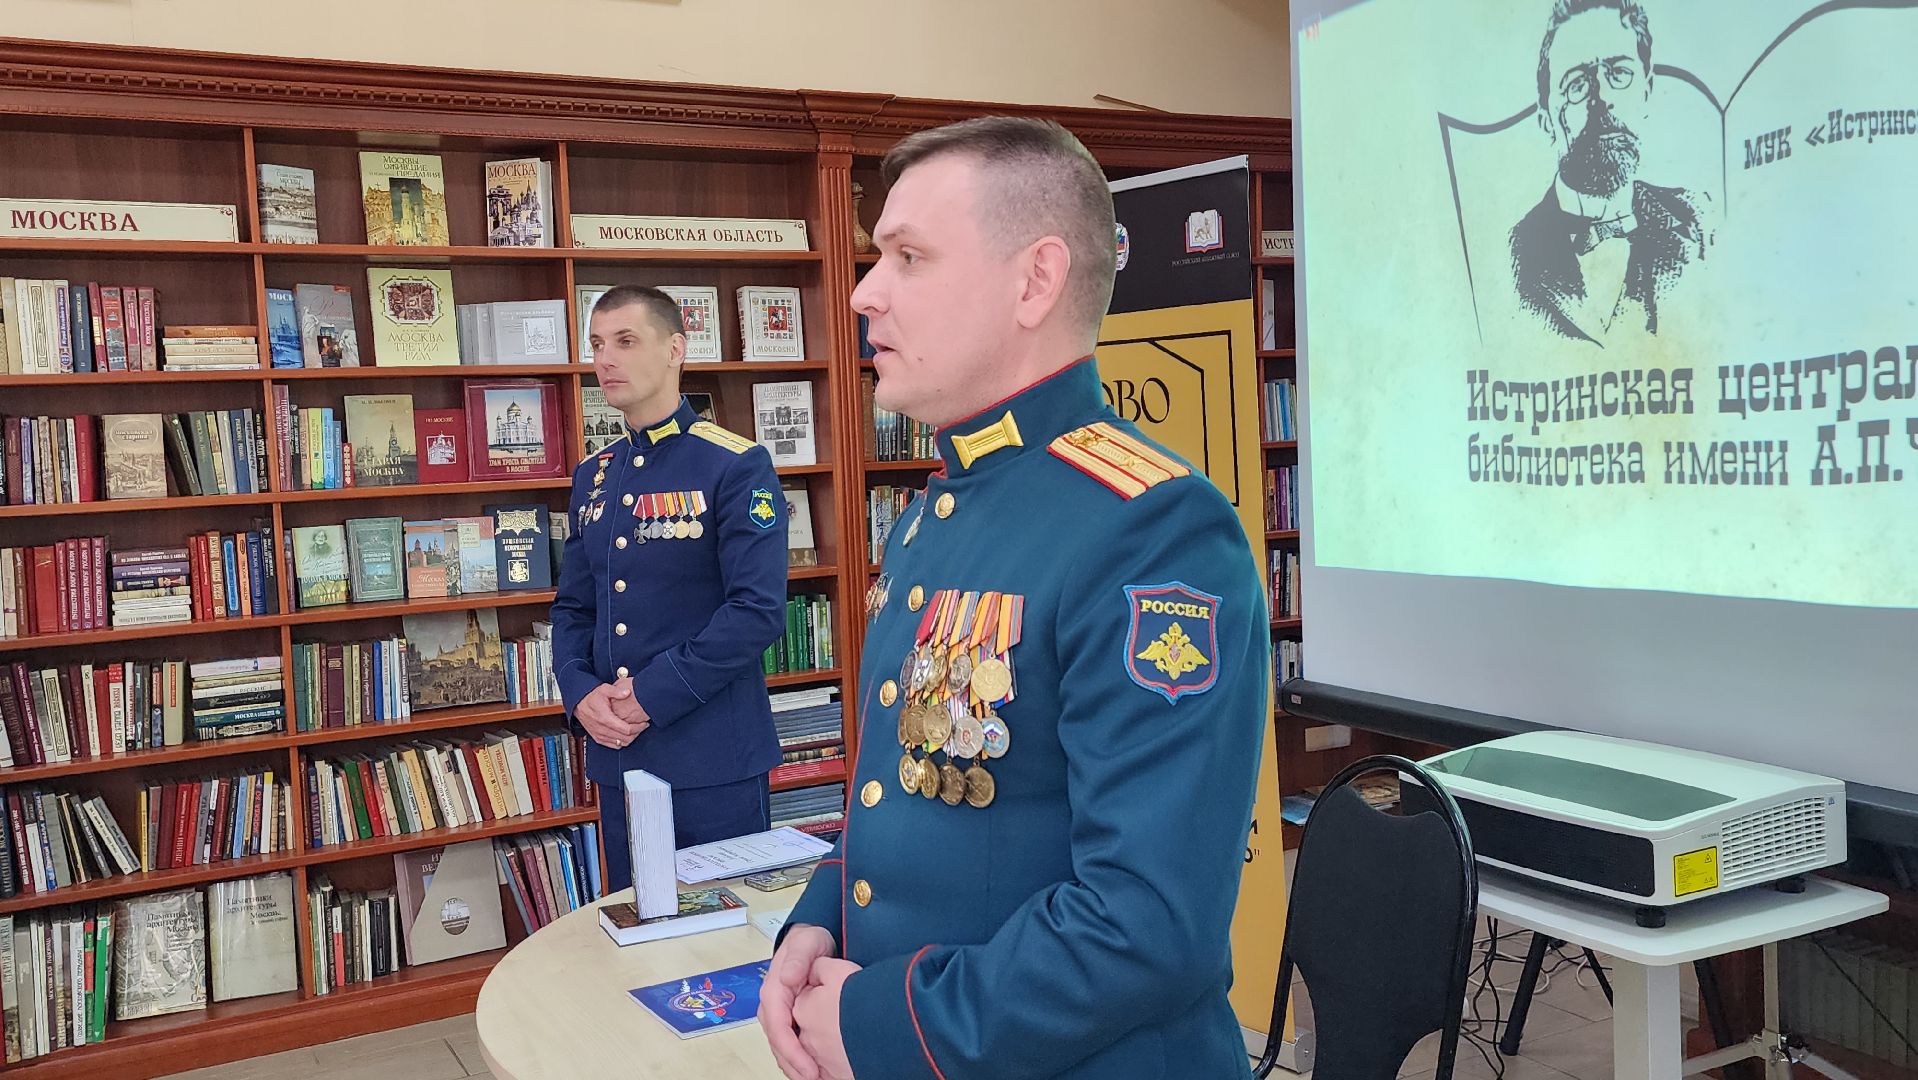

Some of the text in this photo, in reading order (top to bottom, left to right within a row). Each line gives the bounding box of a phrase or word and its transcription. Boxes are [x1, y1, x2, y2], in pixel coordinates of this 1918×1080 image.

[1744, 109, 1918, 170] МУК «Истринс
[488, 162, 537, 179] МОСКВА
[10, 209, 141, 232] МОСКВА
[599, 225, 784, 243] МОСКОВСКАЯ ОБЛАСТЬ
[388, 332, 445, 343] МОСКВА
[394, 342, 439, 352] ТРЕТИЙ
[405, 351, 432, 361] РИМ
[1467, 368, 1694, 436] Истринская
[364, 456, 402, 467] СТАРАЯ
[489, 459, 502, 467] ХРАМ
[1468, 433, 1645, 486] библиотека
[1663, 440, 1789, 485] имени
[363, 466, 405, 477] МОСКВА
[1140, 599, 1210, 620] РОССИЯ
